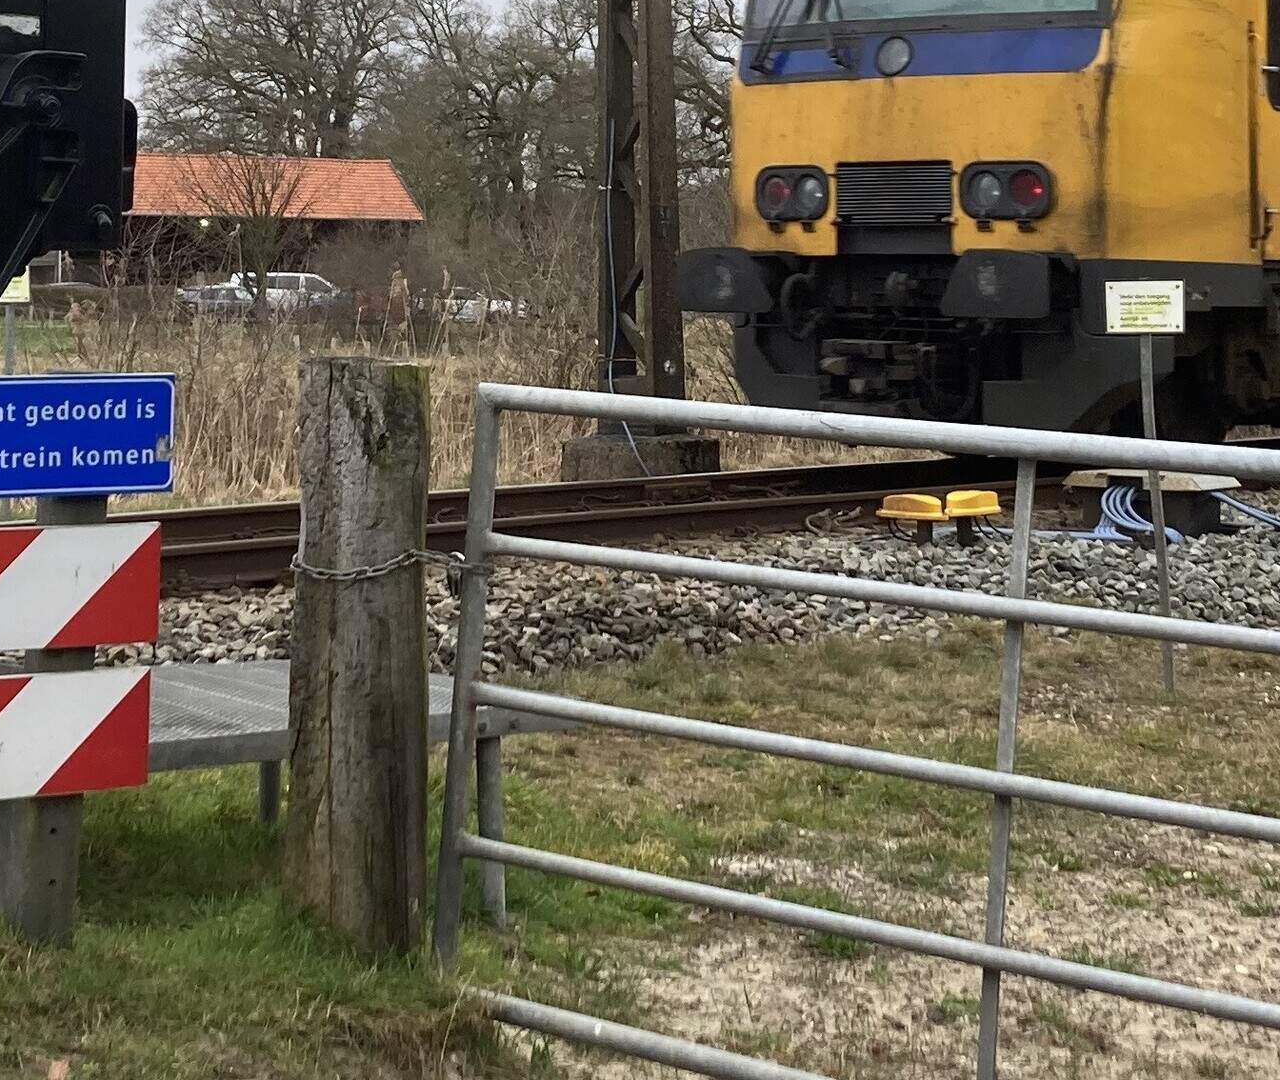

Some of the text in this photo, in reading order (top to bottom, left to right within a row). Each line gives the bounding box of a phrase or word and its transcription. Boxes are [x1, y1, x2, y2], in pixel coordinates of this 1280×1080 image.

[25, 398, 127, 427] gedoofd
[136, 398, 156, 419] is
[0, 446, 61, 469] trein
[72, 446, 154, 466] komen
